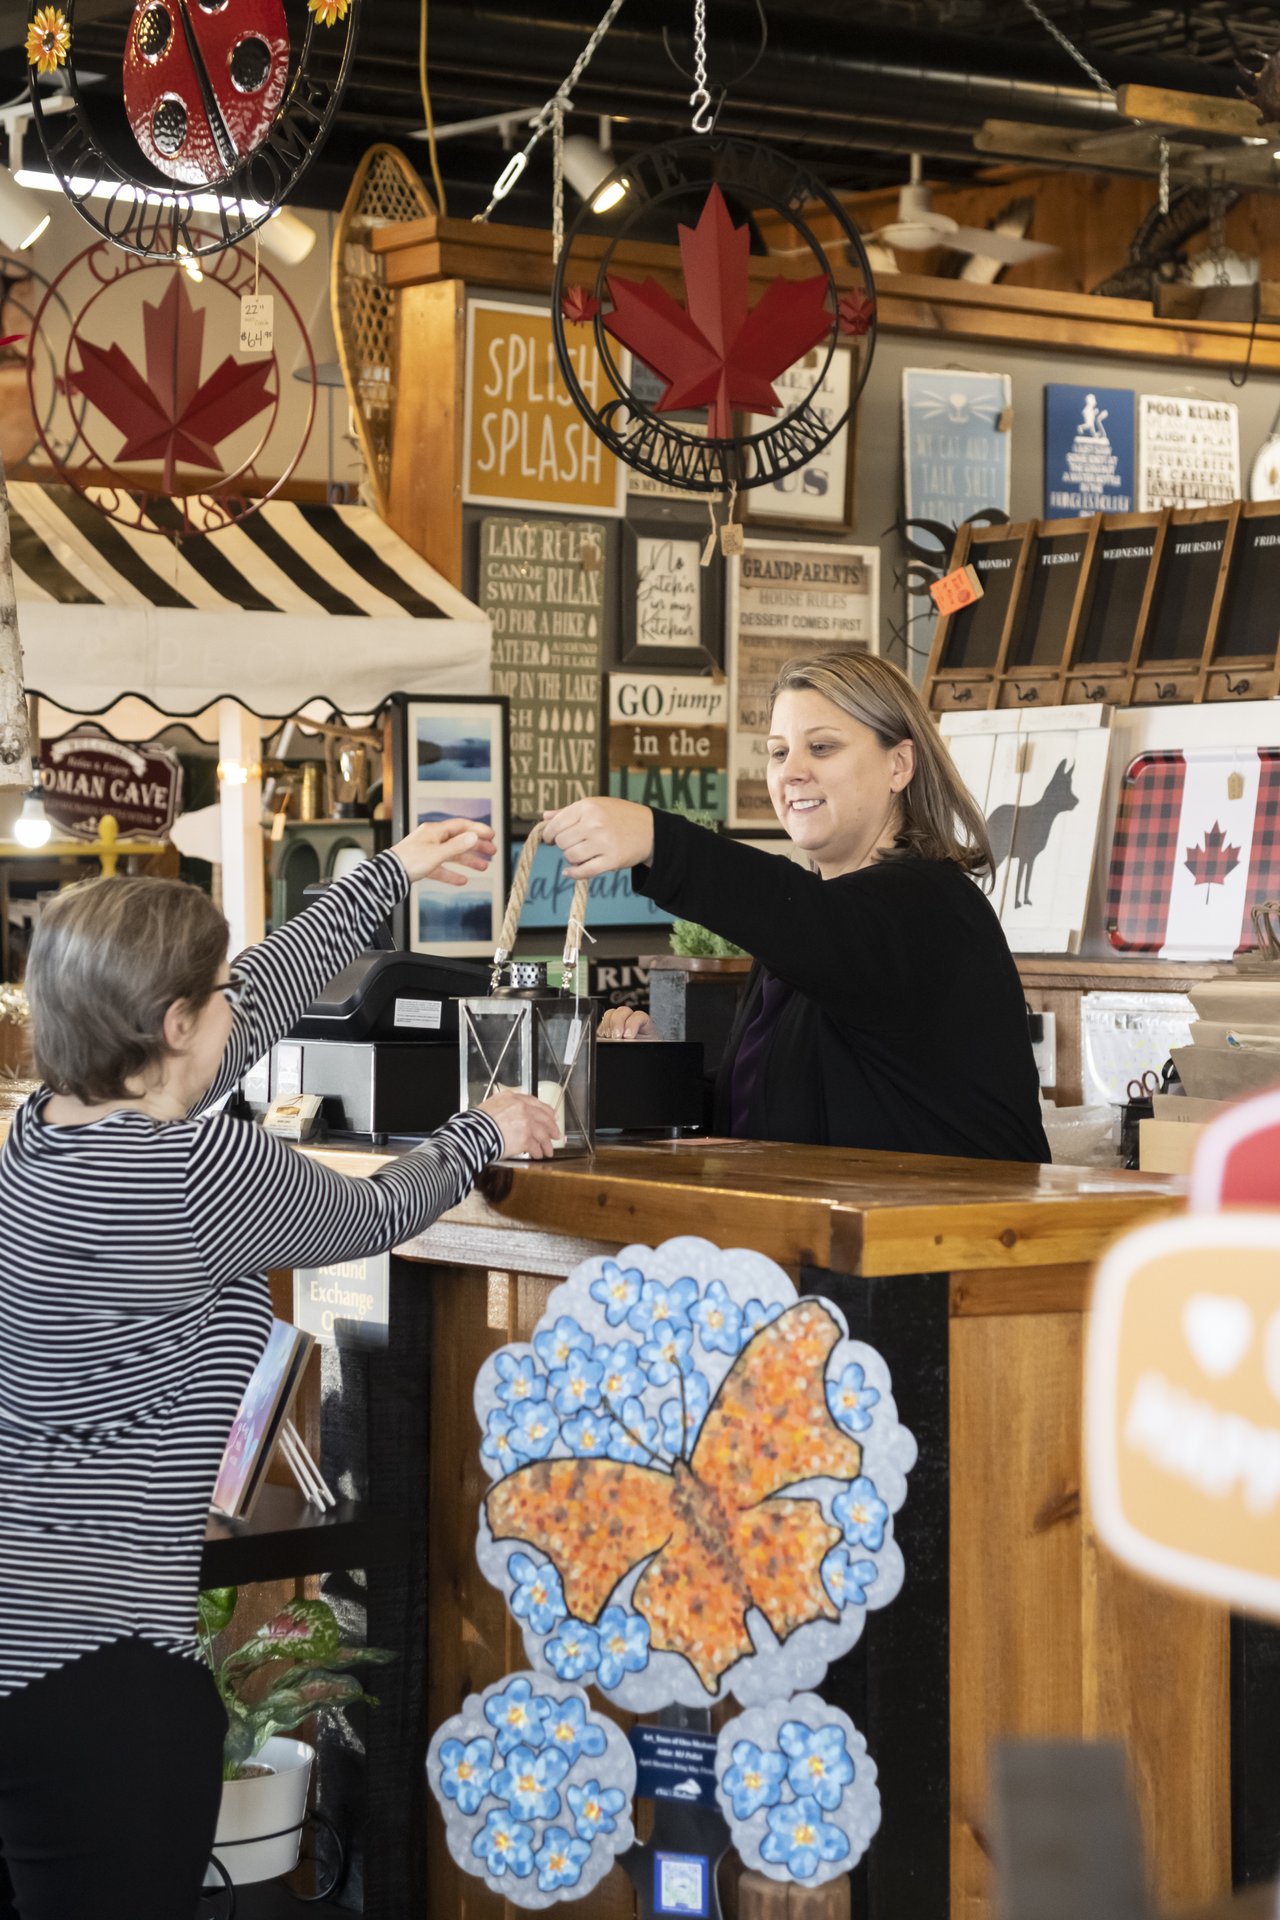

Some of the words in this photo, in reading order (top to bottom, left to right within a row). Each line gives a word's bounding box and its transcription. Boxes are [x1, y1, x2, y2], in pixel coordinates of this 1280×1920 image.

[104, 182, 198, 254] OUR
[1147, 401, 1182, 417] POOL
[477, 408, 600, 485] SPLASH
[488, 525, 537, 559] LAKE
[541, 528, 601, 563] RULES
[650, 540, 685, 573] No
[1041, 551, 1081, 566] TUESDAY
[1103, 545, 1155, 560] WEDNESDAY
[1174, 539, 1224, 555] THURSDAY
[487, 561, 545, 580] CANOE
[977, 558, 1013, 570] MONDAY
[487, 581, 542, 603] SWIM
[545, 566, 601, 605] RELAX
[759, 590, 803, 608] HOUSE
[806, 592, 848, 610] RULES
[509, 609, 537, 634] FOR
[539, 610, 550, 636] A
[552, 611, 586, 637] HIKE
[740, 612, 790, 627] DESSERT
[791, 615, 831, 630] COMES
[833, 617, 862, 632] FIRST
[519, 671, 535, 700] IN
[536, 672, 562, 701] THE
[565, 673, 598, 703] LAKE
[617, 683, 664, 717] GO
[666, 687, 722, 717] jump
[537, 737, 597, 775] HAVE
[633, 727, 659, 756] in
[669, 727, 711, 757] the
[40, 767, 106, 800] OMAN
[109, 778, 169, 810] CAVE
[310, 1280, 375, 1316] Exchange
